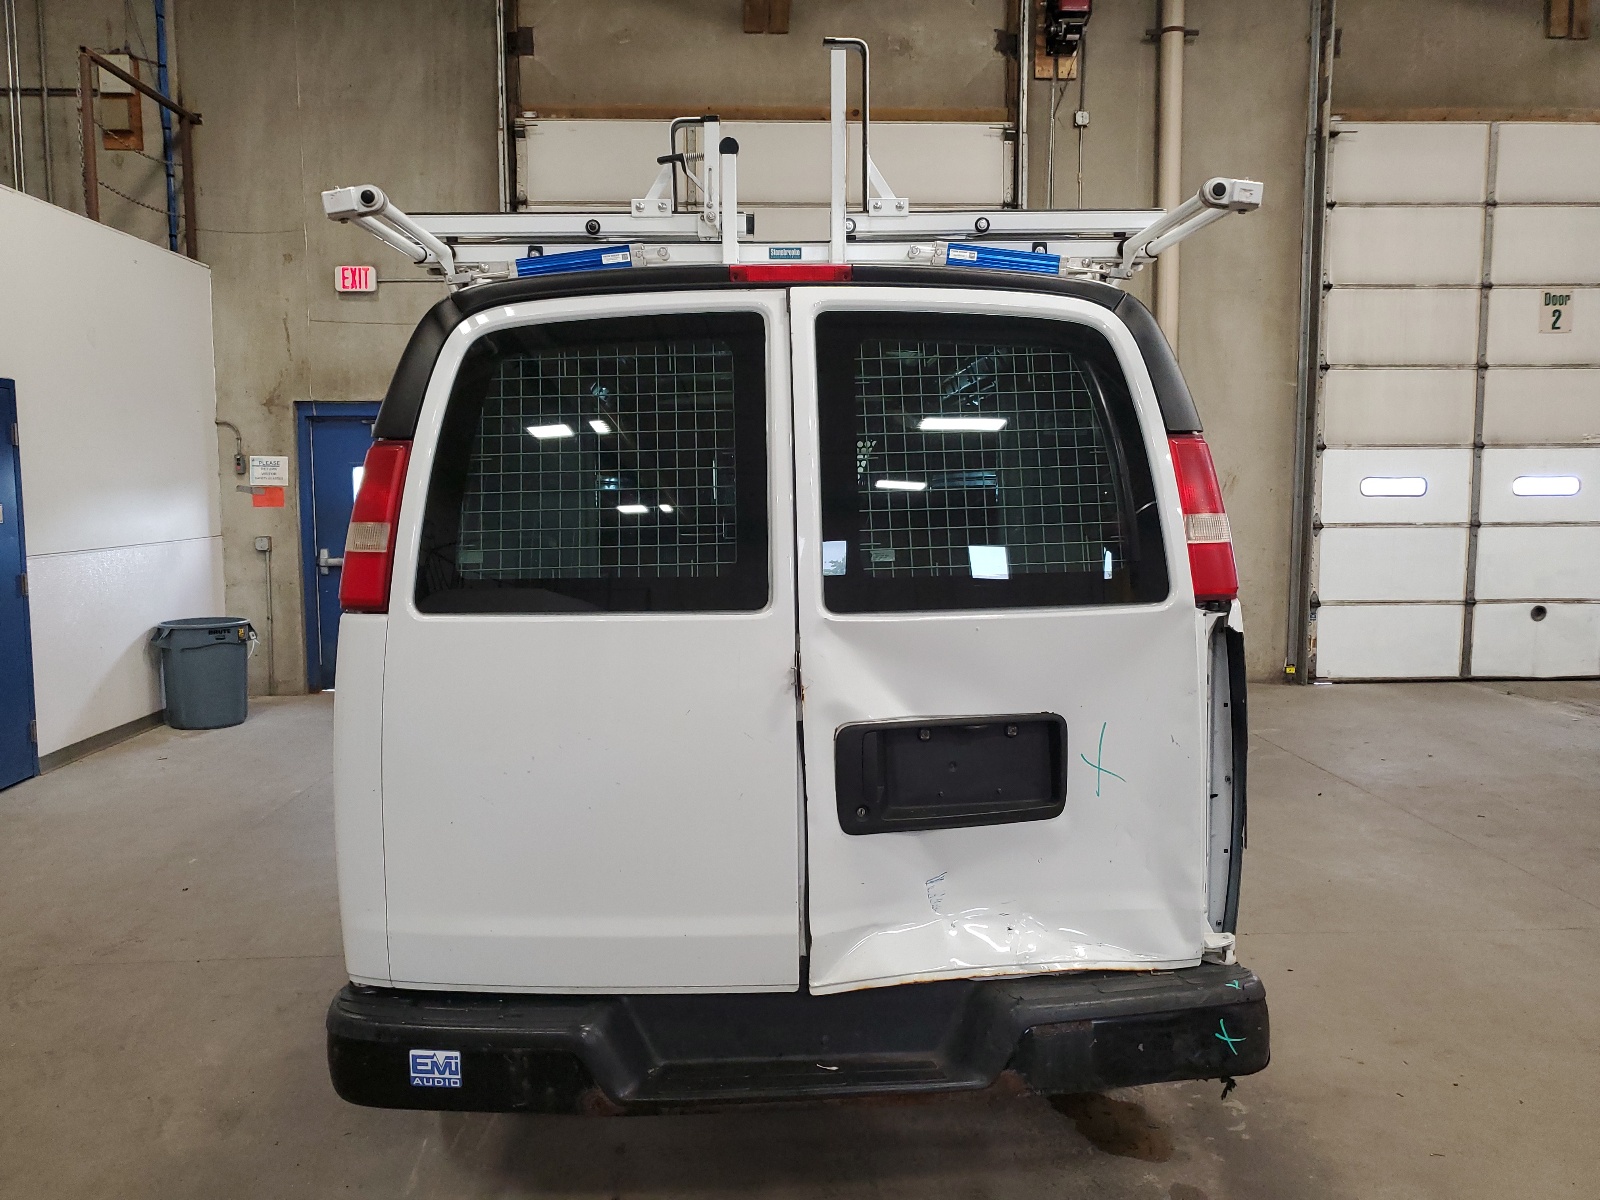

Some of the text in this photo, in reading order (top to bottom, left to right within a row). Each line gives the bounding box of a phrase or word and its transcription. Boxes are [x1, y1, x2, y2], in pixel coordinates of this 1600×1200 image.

[341, 267, 370, 290] EXIT
[1544, 292, 1571, 306] Door
[1551, 309, 1562, 330] 2
[413, 1077, 460, 1087] AUDIO
